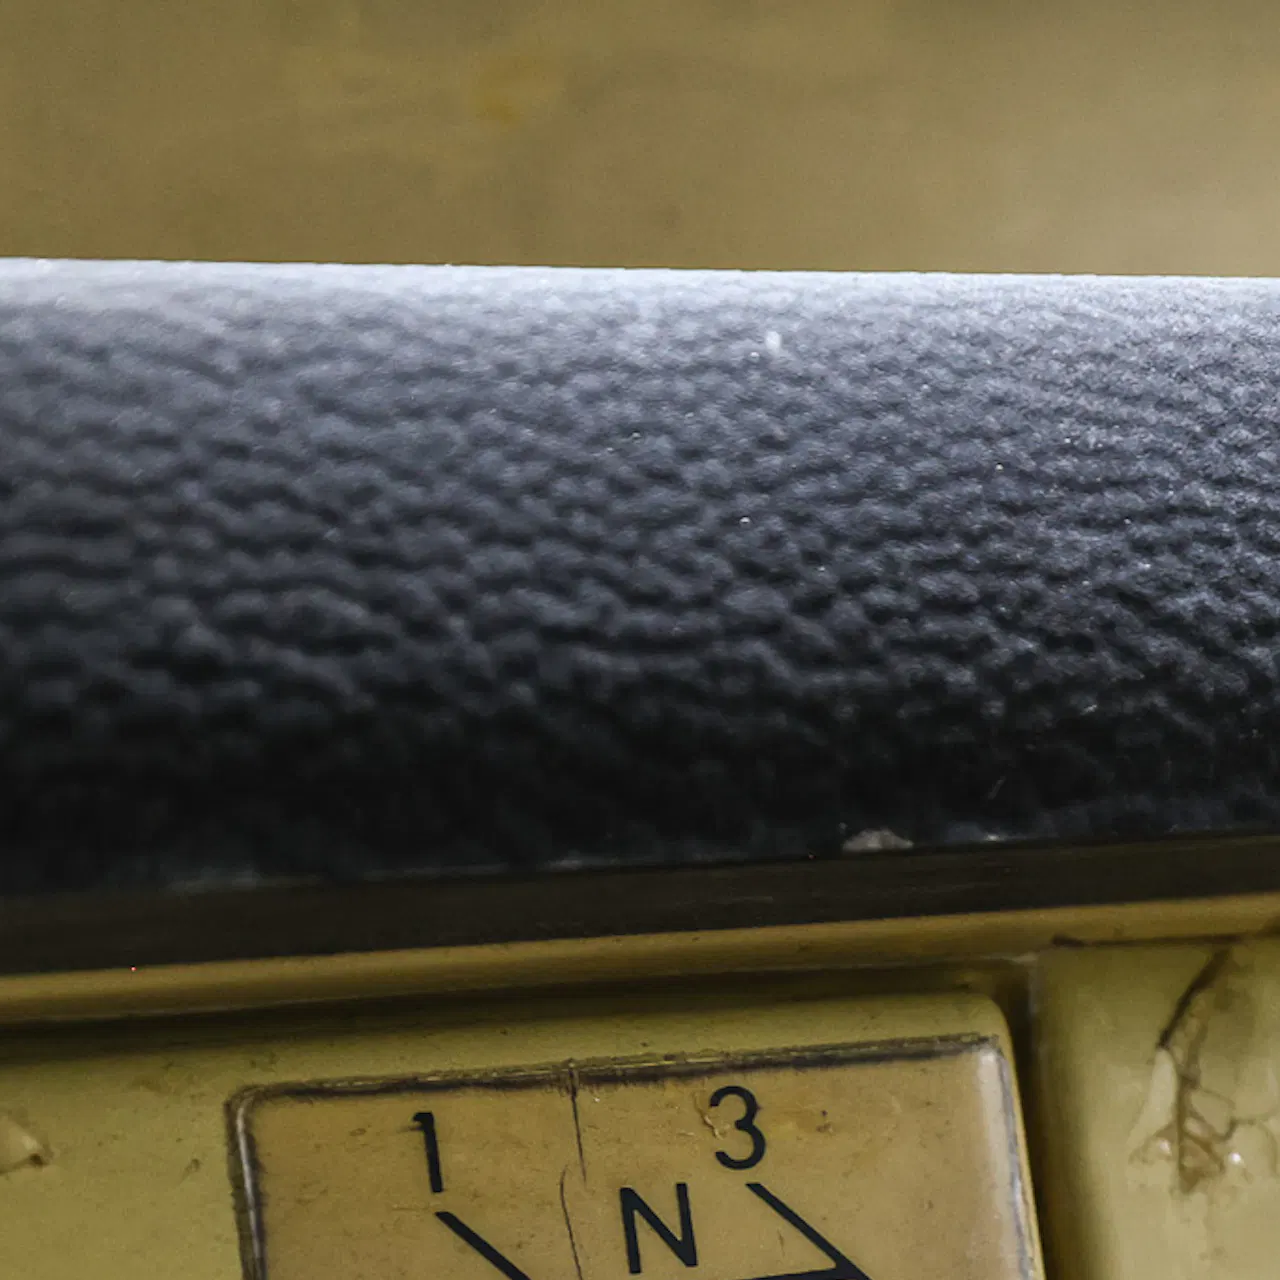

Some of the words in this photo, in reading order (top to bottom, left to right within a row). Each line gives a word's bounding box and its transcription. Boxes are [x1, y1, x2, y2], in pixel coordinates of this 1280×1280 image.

[408, 1111, 446, 1194] 1
[708, 1085, 767, 1171] 3
[618, 1182, 700, 1275] N
